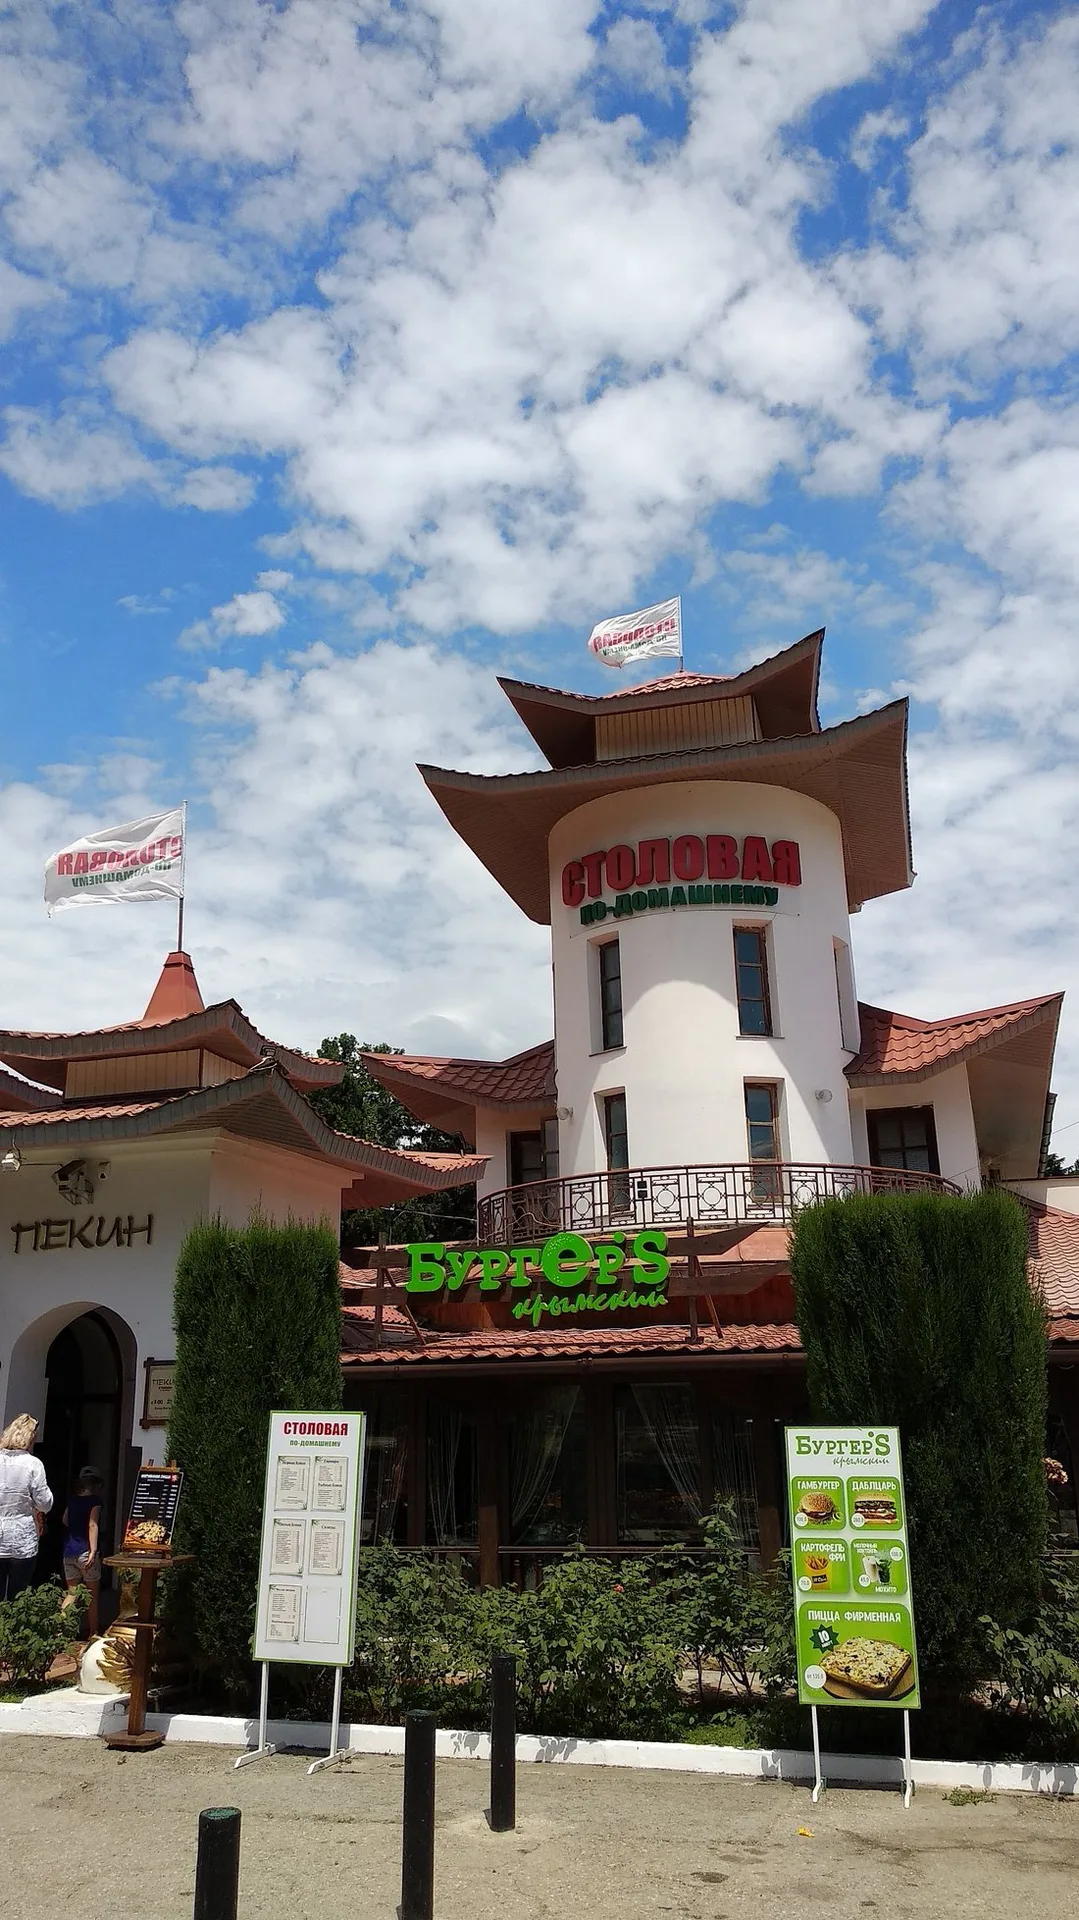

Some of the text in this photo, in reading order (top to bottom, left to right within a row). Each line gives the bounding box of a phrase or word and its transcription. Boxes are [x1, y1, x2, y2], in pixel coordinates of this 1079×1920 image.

[561, 834, 802, 907] СТОЛОВАЯ
[580, 884, 779, 926] ПО-ДОМАШНЕМУ
[10, 1214, 154, 1254] ПЕКИН
[512, 1282, 669, 1327] крымский
[284, 1421, 349, 1436] СТОЛОВАЯ
[289, 1440, 341, 1448] ПО-ДОМАШНЕМУ
[797, 1480, 840, 1490] ГАМБУРГЕР
[852, 1481, 897, 1491] ДАБЛЦАРЬ
[800, 1543, 845, 1552] КАРТОФЕЛЬ
[828, 1552, 846, 1562] ФРИ
[808, 1610, 901, 1623] ПИЦЦА ФИРМЕННАЯ
[817, 1630, 830, 1643] 10
